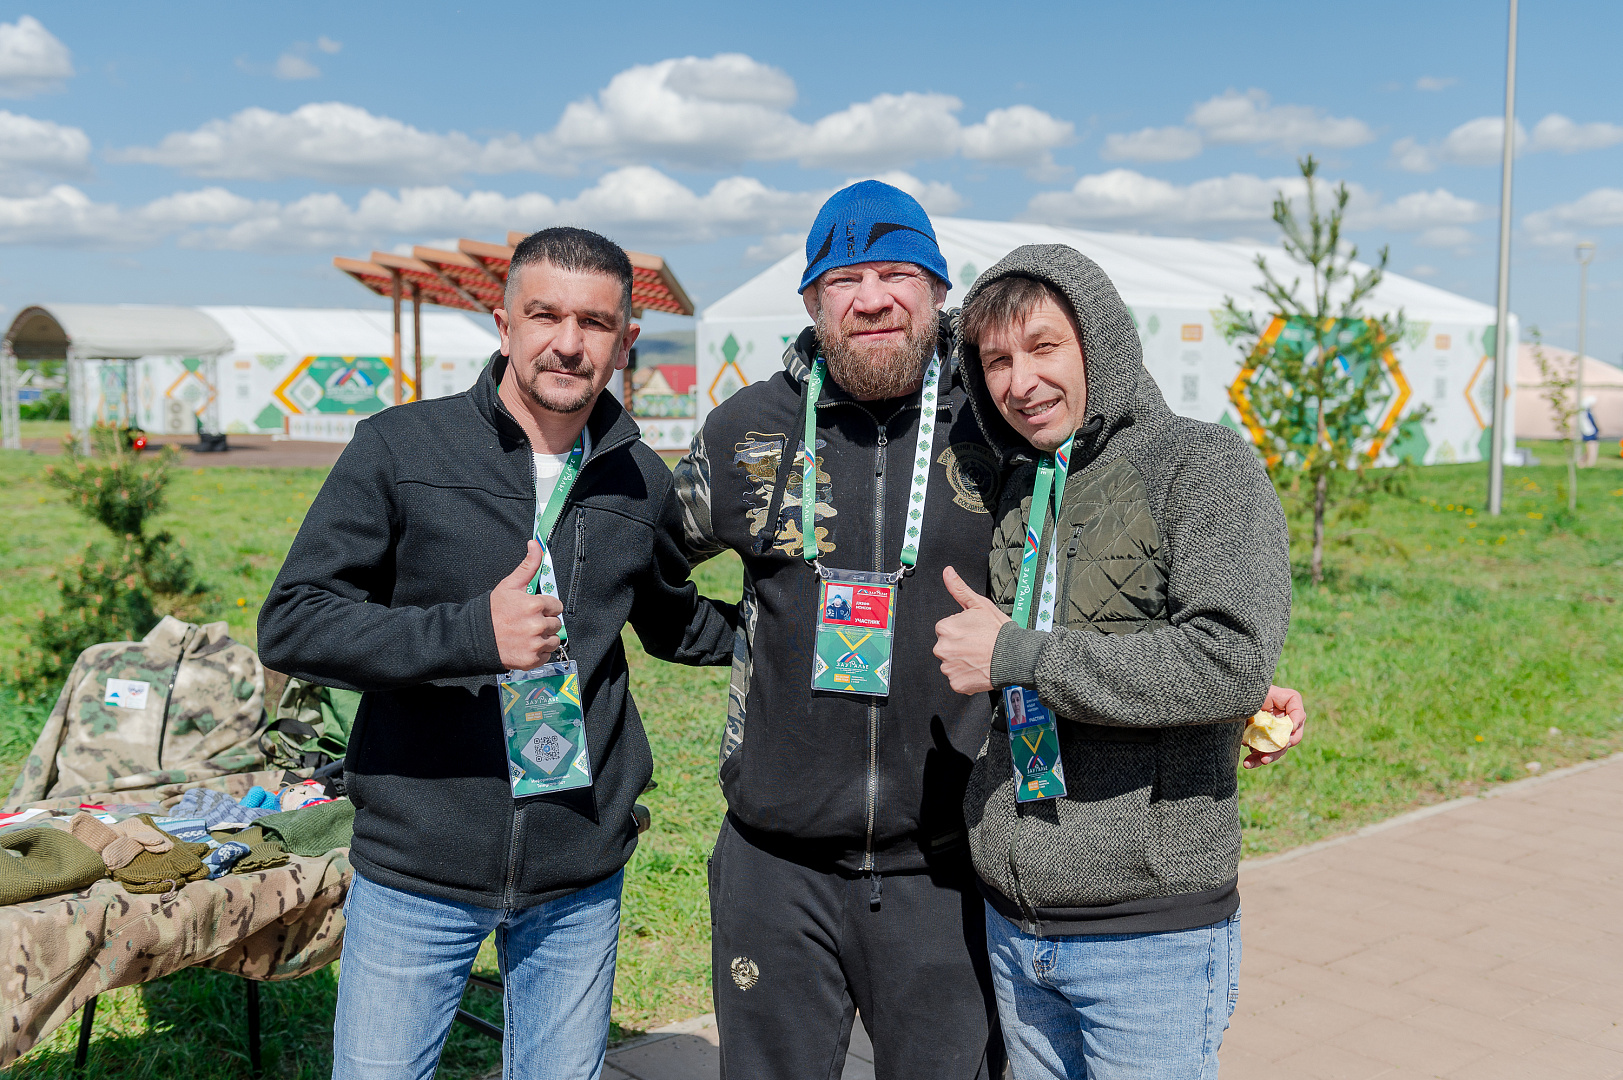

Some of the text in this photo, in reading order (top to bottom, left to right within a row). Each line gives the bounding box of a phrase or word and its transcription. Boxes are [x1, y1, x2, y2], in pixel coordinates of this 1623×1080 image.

[804, 482, 813, 523] ЗАУРАЛЬЕ
[1017, 566, 1031, 611] ЗАУРАЛЬЕ
[836, 660, 869, 669] ЗАУРАЛЬЕ
[525, 695, 559, 705] ЗАУРАЛЬЕ
